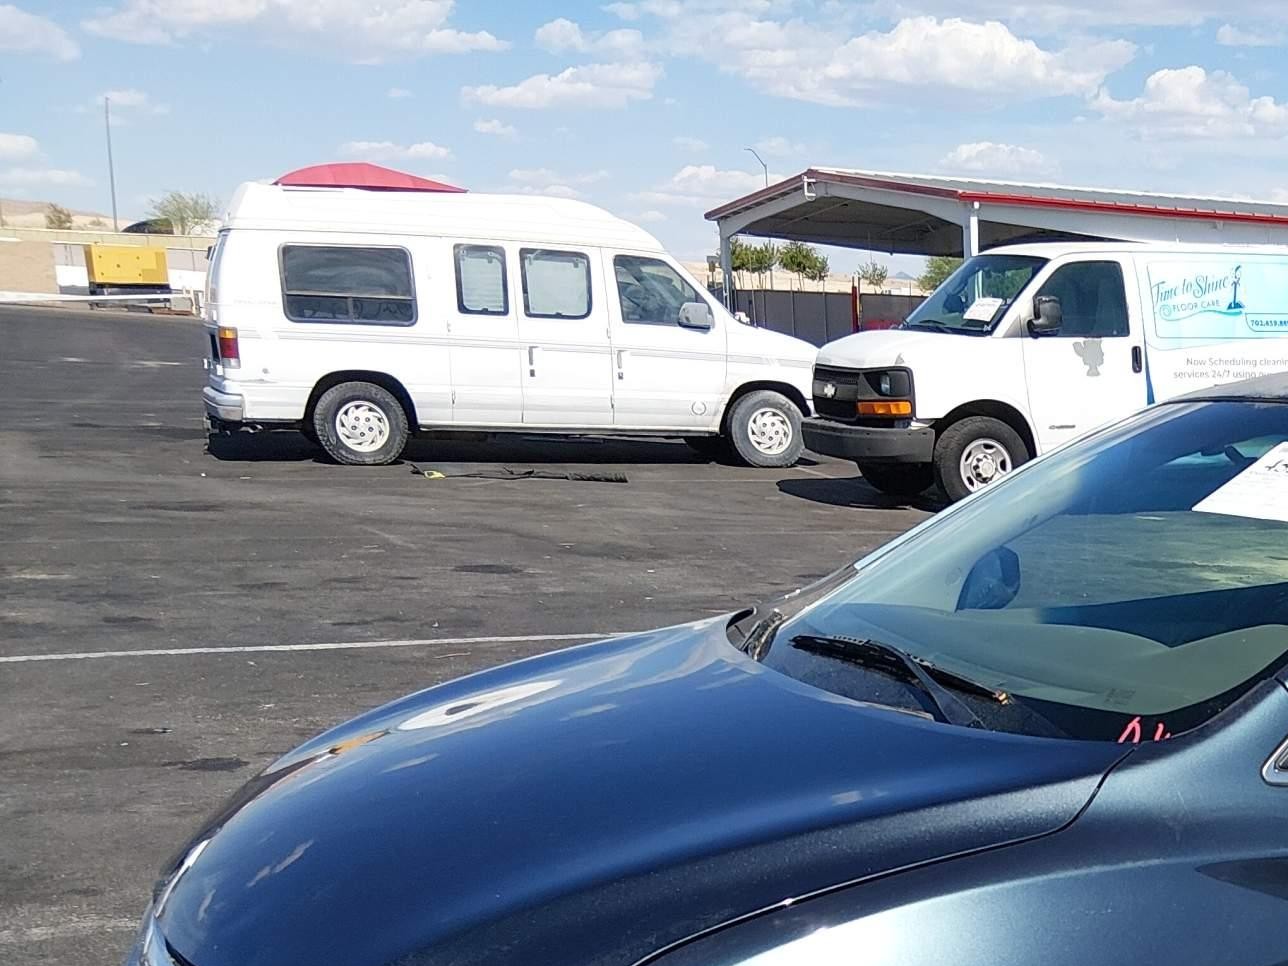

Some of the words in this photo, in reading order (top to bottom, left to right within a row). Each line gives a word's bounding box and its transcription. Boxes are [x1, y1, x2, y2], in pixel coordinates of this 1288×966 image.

[1151, 280, 1179, 307] Time
[1182, 278, 1193, 295] to
[1193, 275, 1229, 299] Shine
[1172, 302, 1198, 313] FLOOR
[1200, 299, 1221, 310] CARE
[1186, 357, 1206, 367] Now
[1208, 357, 1257, 368] Scheduling
[1173, 370, 1210, 379] services
[1211, 369, 1230, 379] 24/7
